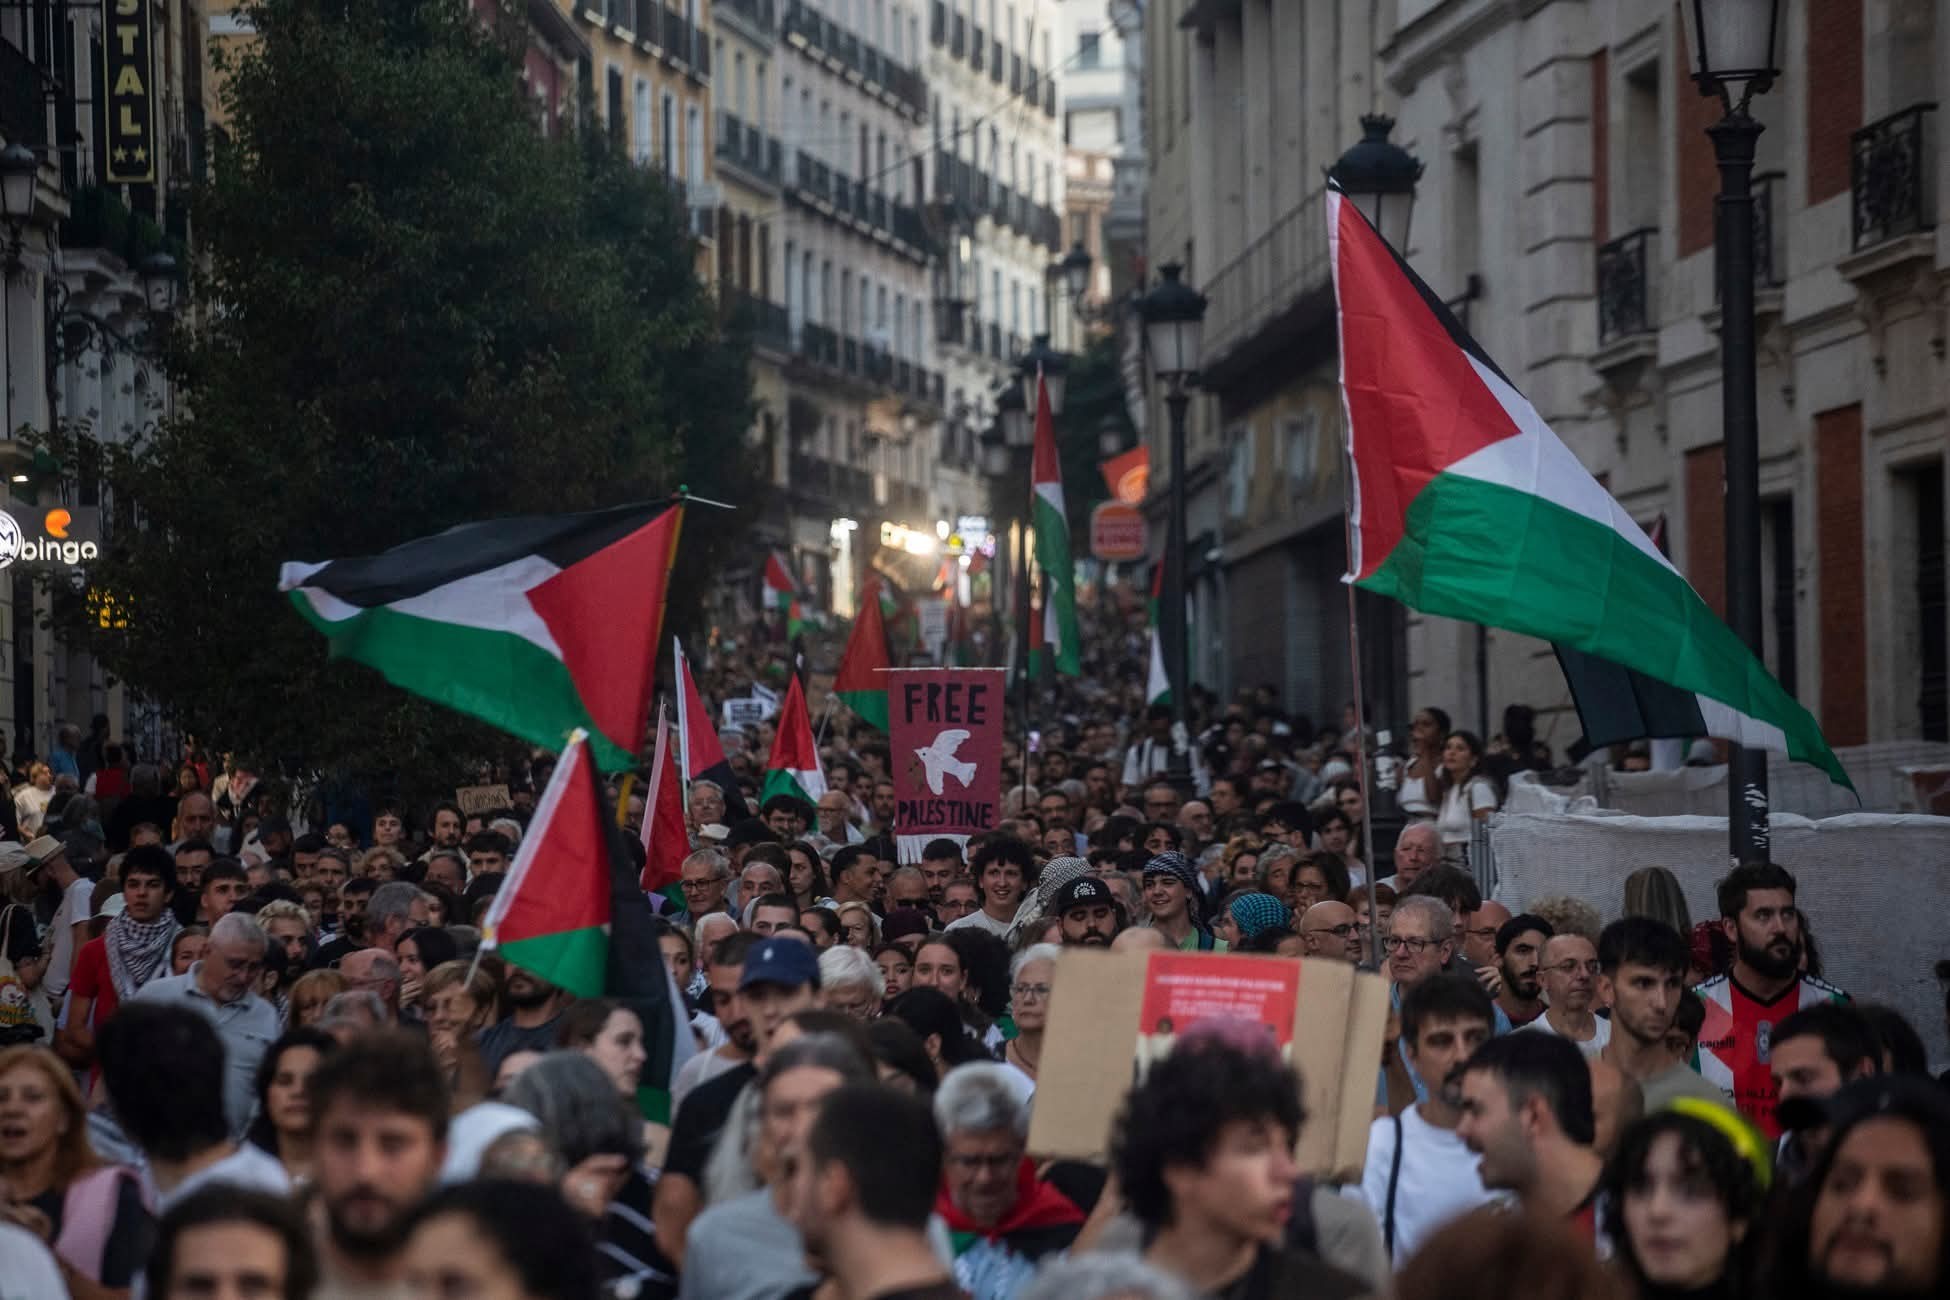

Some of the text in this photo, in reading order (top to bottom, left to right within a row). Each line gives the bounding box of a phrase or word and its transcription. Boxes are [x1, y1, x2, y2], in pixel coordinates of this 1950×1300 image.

[21, 535, 98, 565] bingo
[904, 682, 987, 725] FREE
[898, 801, 993, 829] PALESTINE
